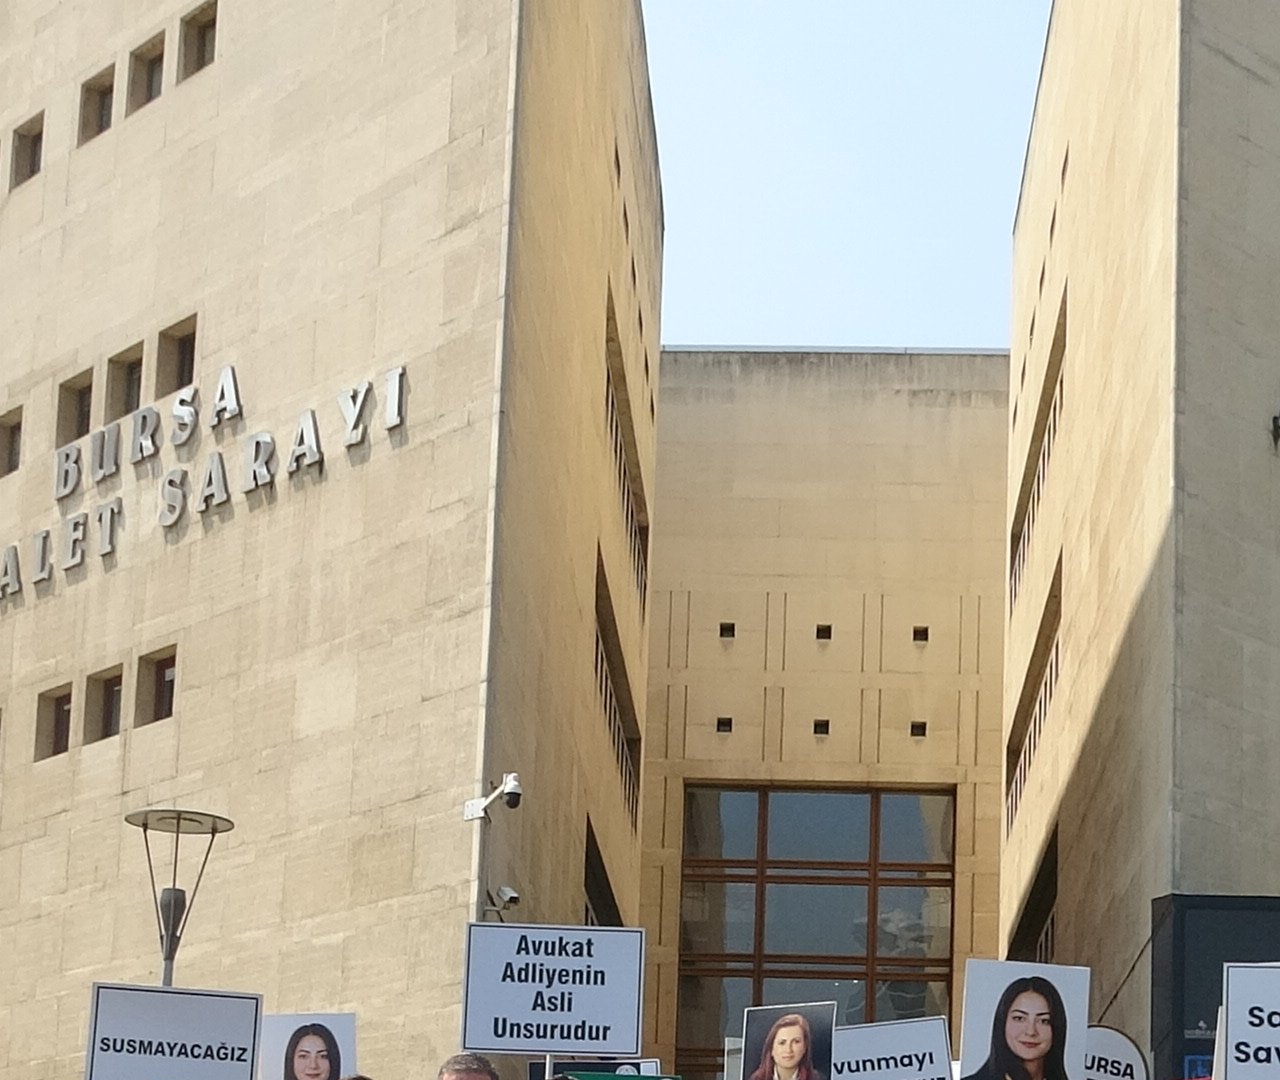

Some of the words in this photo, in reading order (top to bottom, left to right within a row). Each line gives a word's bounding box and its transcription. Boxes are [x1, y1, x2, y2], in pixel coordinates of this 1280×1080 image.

[55, 366, 241, 500] BURSA
[158, 366, 406, 527] SARAYI
[516, 935, 594, 958] Avukat
[501, 962, 606, 988] Adliyenin
[531, 991, 573, 1012] Asli
[493, 1017, 611, 1041] Unsurudur
[99, 1037, 249, 1062] SUSMAYACAĞIZ
[833, 1051, 935, 1076] vunmayı
[1085, 1053, 1135, 1080] URSA
